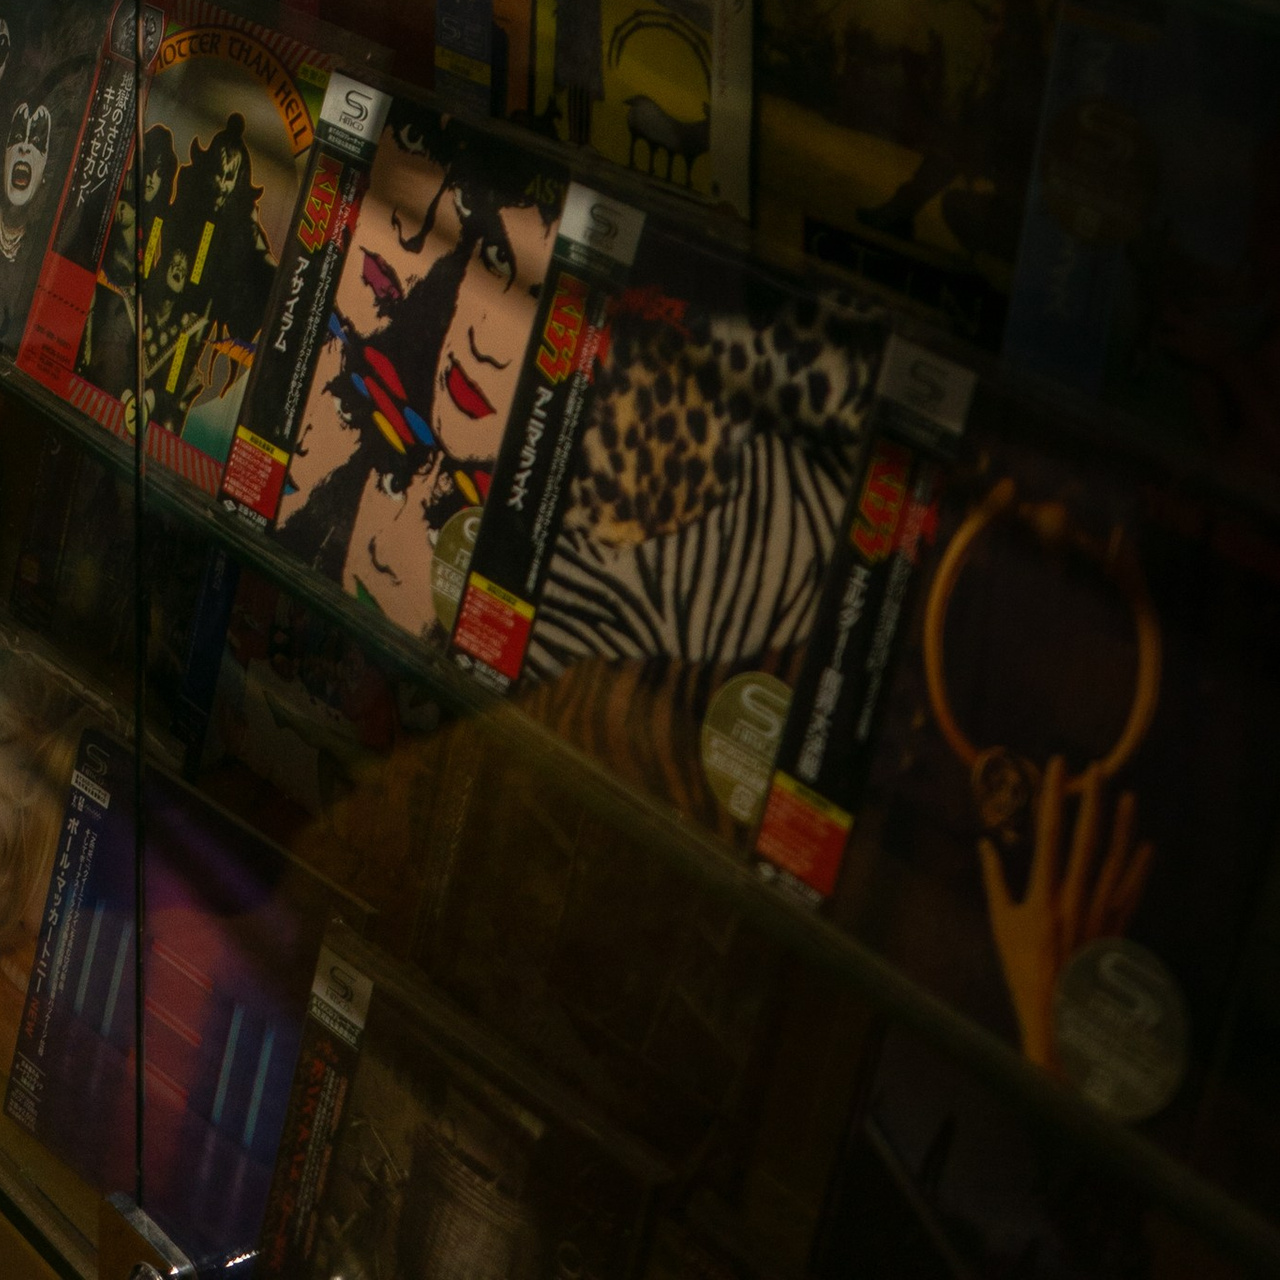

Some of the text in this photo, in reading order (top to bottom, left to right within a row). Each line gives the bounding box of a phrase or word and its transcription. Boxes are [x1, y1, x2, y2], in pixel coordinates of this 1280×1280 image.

[76, 86, 116, 209] キッス・セカンド
[225, 36, 275, 84] THAN
[273, 80, 308, 148] HELL
[273, 255, 311, 354] アサイラム
